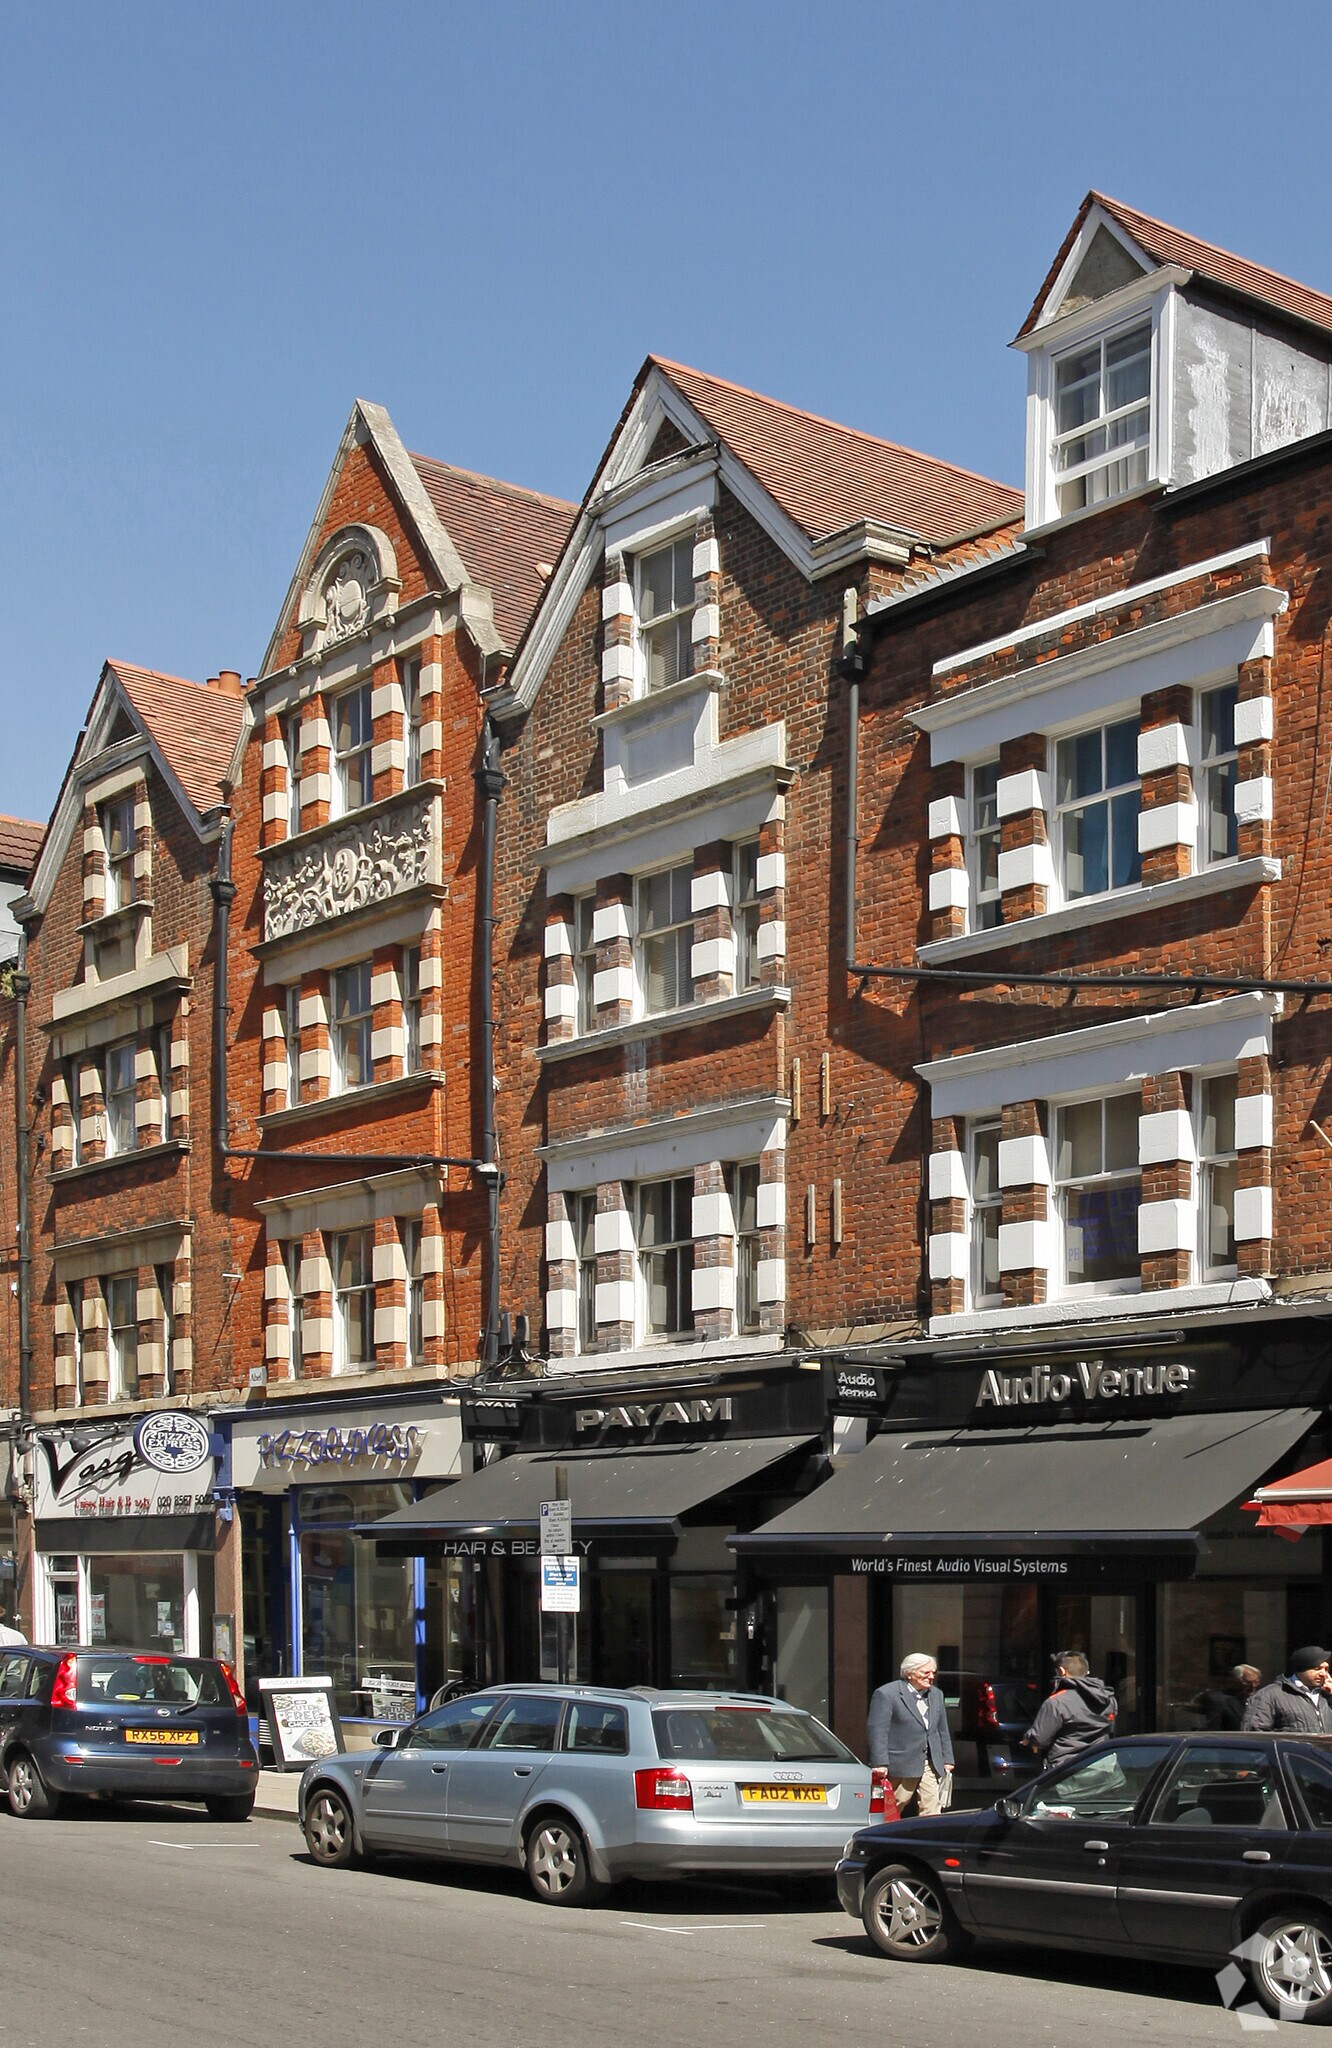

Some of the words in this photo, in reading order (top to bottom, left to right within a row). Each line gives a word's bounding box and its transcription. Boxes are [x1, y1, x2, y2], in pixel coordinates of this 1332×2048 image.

[837, 1371, 876, 1386] Audio
[975, 1365, 1072, 1407] Audio
[1077, 1361, 1191, 1399] Venue
[837, 1385, 878, 1399] Venue
[465, 1400, 517, 1409] PAYAM
[576, 1398, 733, 1432] PAYAM
[157, 1430, 192, 1442] PIZZA
[149, 1438, 201, 1450] EXPRESS
[157, 1496, 171, 1508] 020
[542, 1504, 548, 1516] P
[443, 1541, 487, 1555] HAIR
[491, 1541, 507, 1555] &
[511, 1540, 593, 1555] BEY
[851, 1558, 893, 1573] World's
[896, 1558, 932, 1573] Finest
[936, 1558, 971, 1573] Audio
[974, 1558, 1011, 1573] Visual
[1013, 1558, 1068, 1576] Systems
[132, 1730, 166, 1742] RX56
[169, 1731, 194, 1742] XPZ
[749, 1785, 789, 1800] FA02
[793, 1787, 822, 1801] WXG
